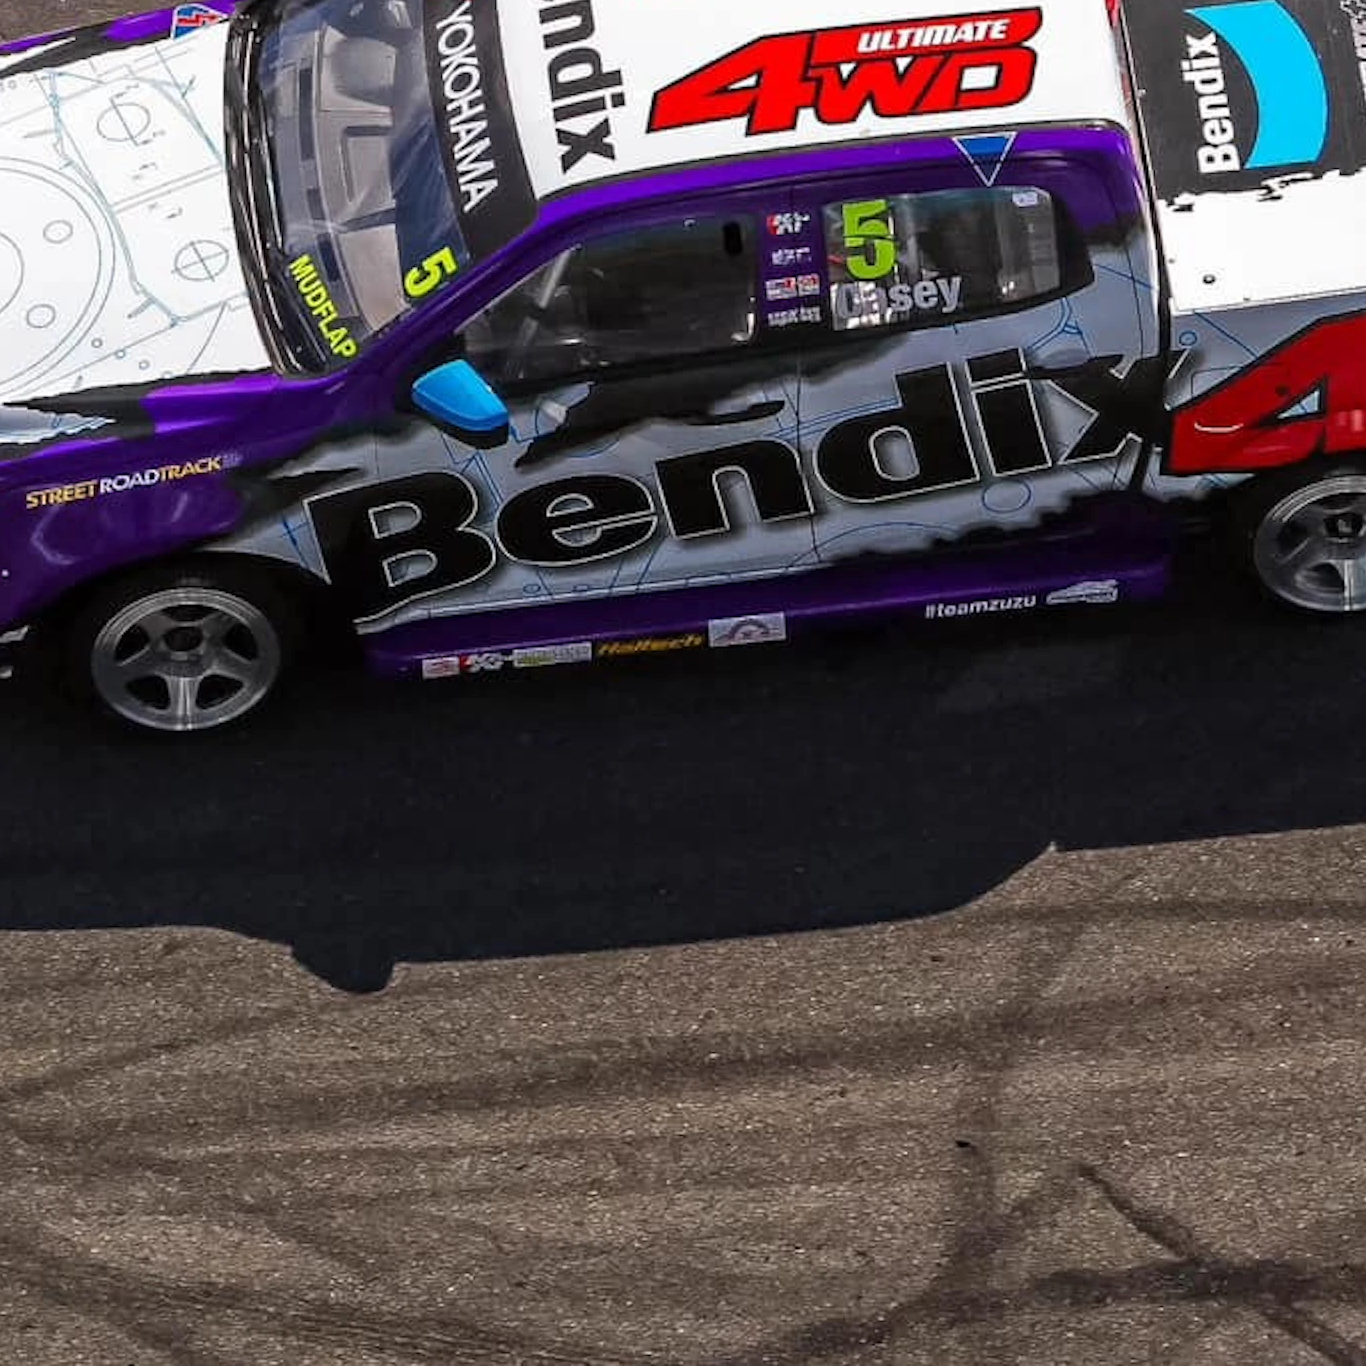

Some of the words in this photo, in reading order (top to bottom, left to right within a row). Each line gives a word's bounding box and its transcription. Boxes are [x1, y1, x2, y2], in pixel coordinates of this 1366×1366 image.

[645, 30, 1037, 137] 4WD
[856, 18, 1011, 54] ULTIMATE
[1181, 32, 1241, 175] Bendix
[402, 245, 461, 302] 5
[841, 198, 896, 280] 5
[287, 254, 357, 361] MUDFLAP
[301, 345, 1192, 635] Bendix
